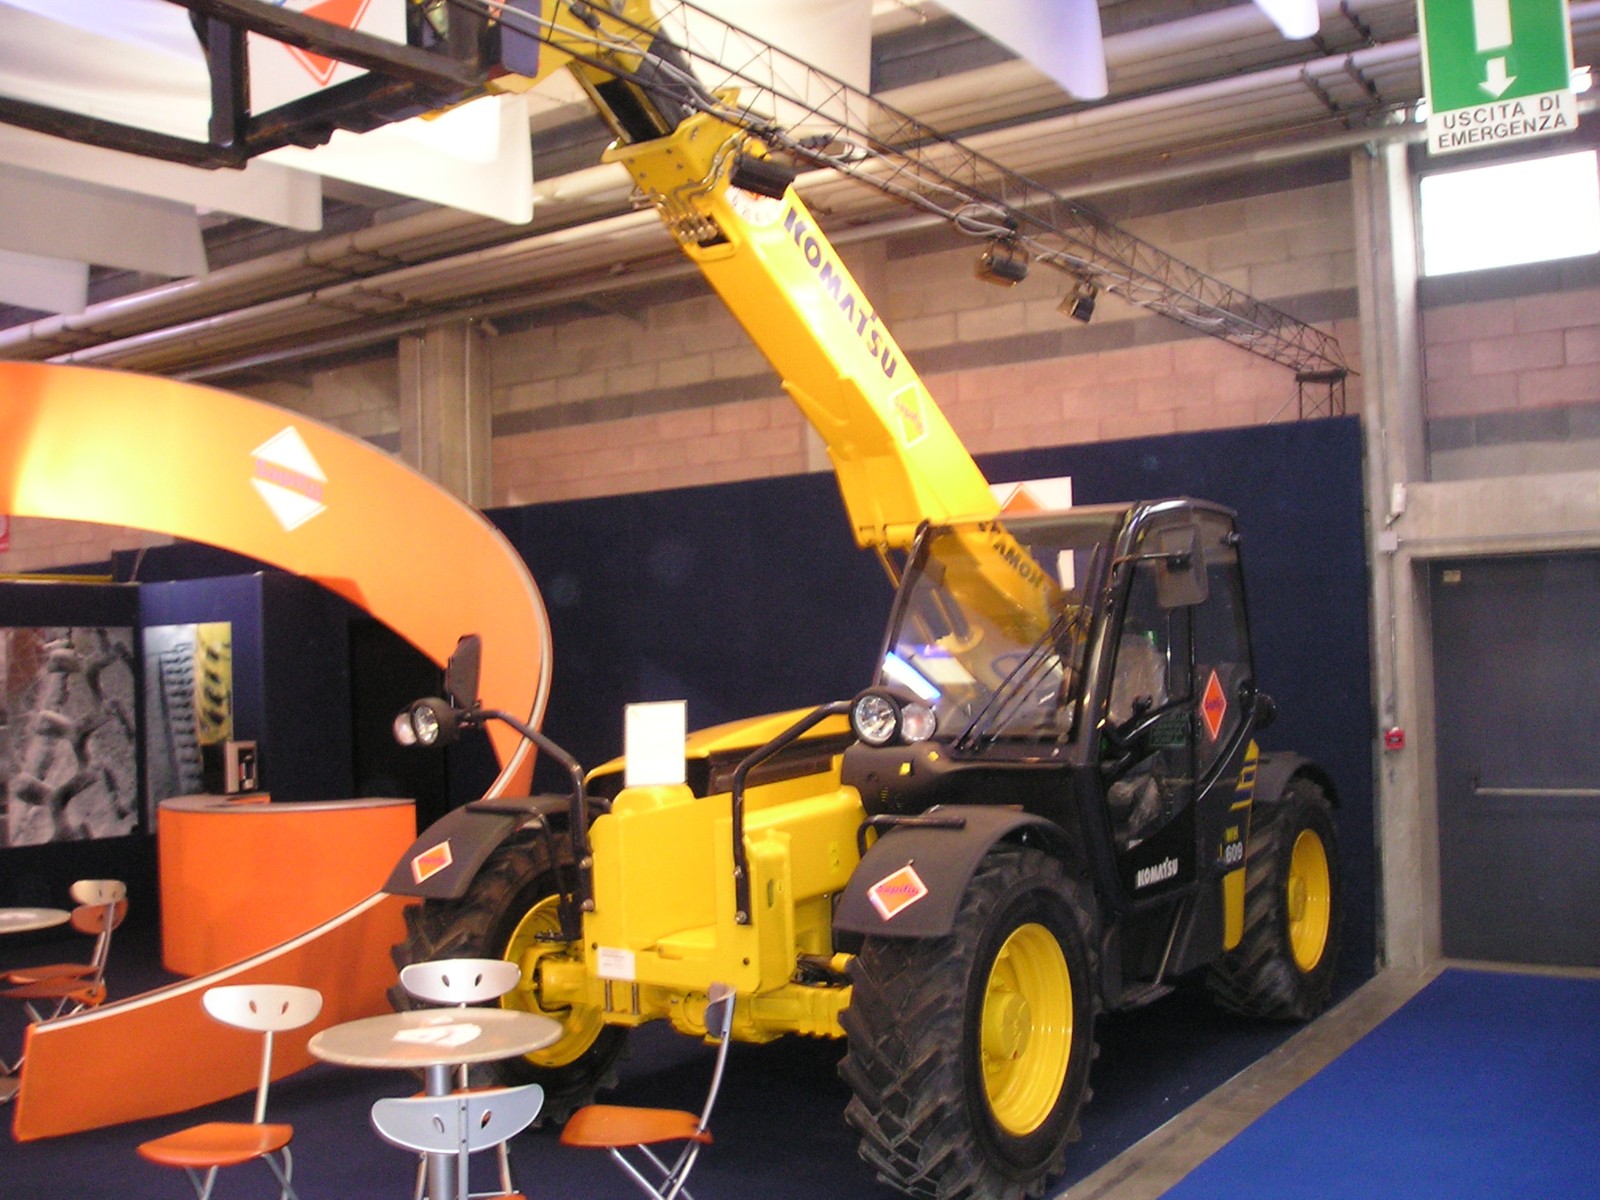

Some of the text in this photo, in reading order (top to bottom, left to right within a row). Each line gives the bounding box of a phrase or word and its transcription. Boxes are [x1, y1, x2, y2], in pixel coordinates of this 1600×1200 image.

[1443, 95, 1560, 130] USCITA DI
[1438, 113, 1567, 149] EMERGENZA
[784, 207, 898, 379] KOMATSU
[1225, 841, 1244, 864] 609
[1137, 857, 1179, 887] KOMATSU
